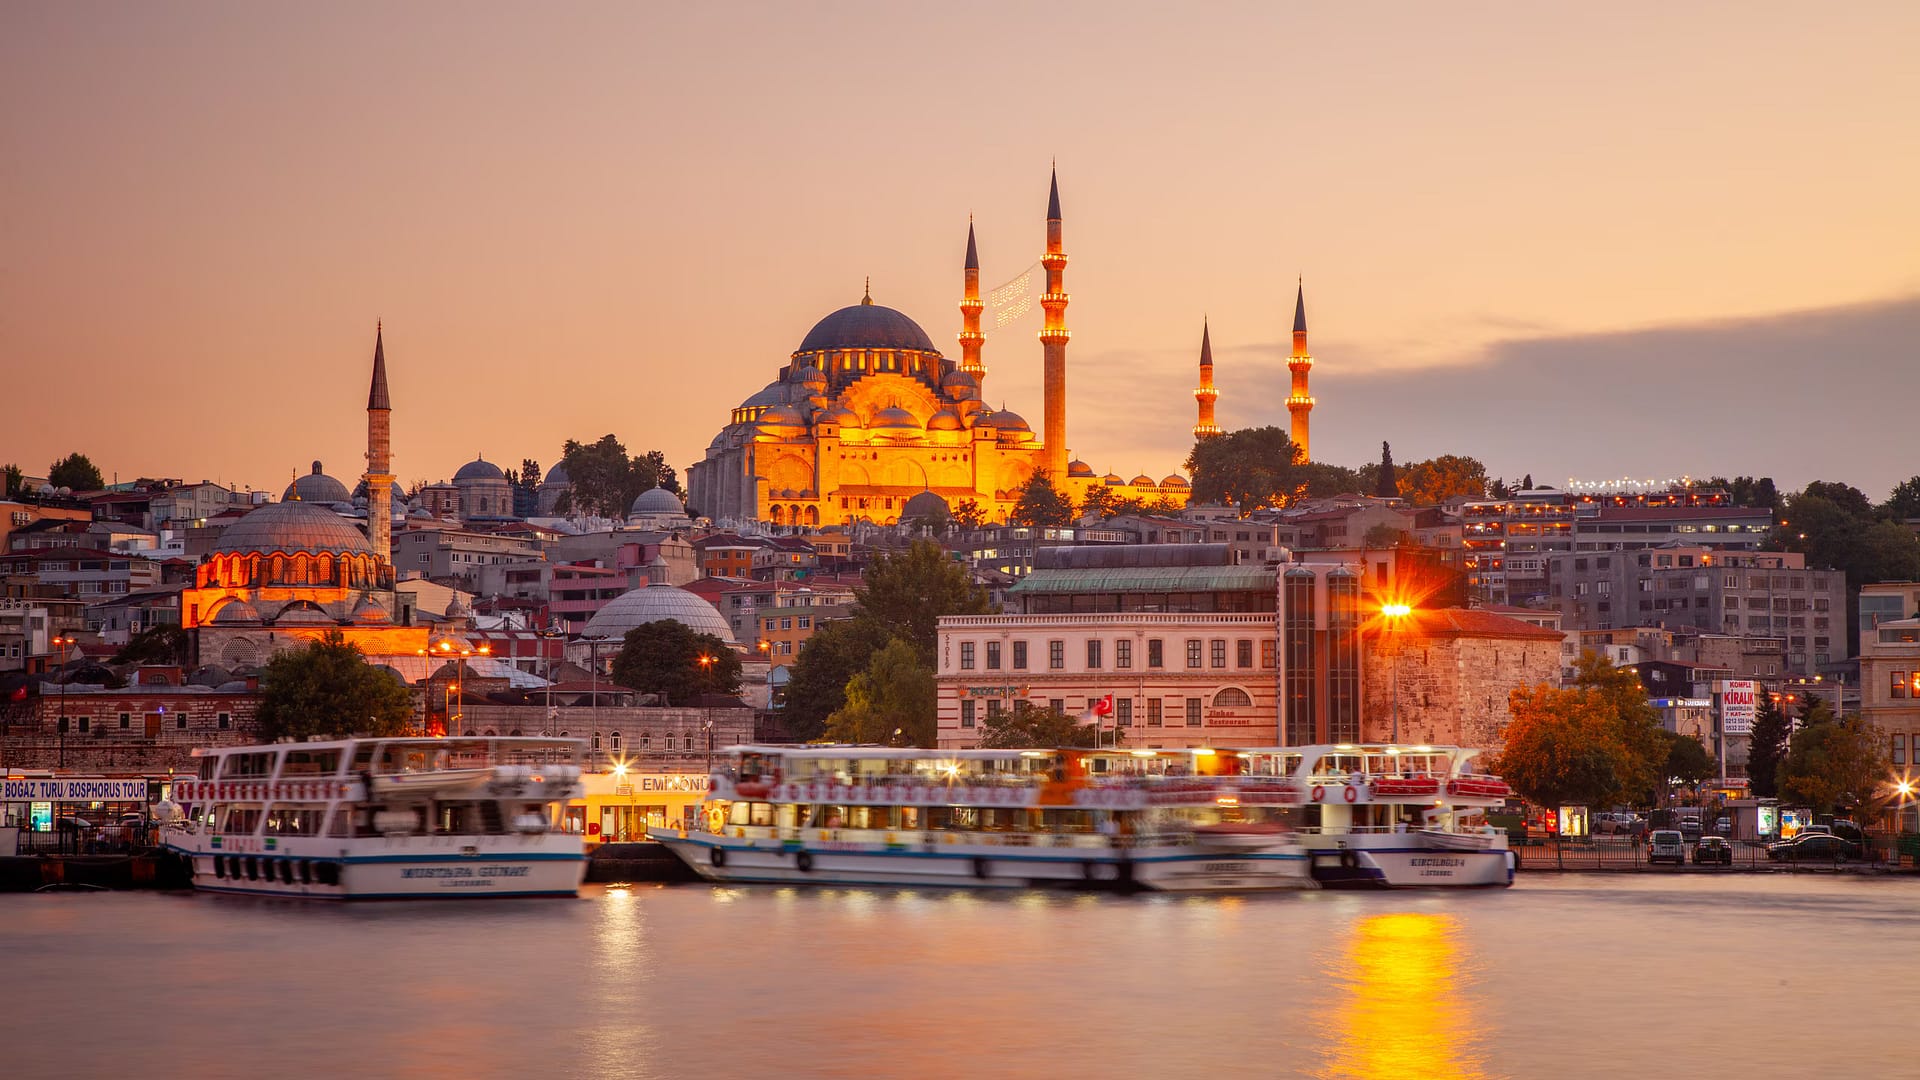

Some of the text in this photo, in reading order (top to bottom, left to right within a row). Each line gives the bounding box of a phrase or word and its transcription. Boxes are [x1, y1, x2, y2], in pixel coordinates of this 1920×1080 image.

[1724, 689, 1754, 704] KİRALIK
[5, 780, 35, 798] BOĞAZ
[123, 782, 145, 798] TOUR
